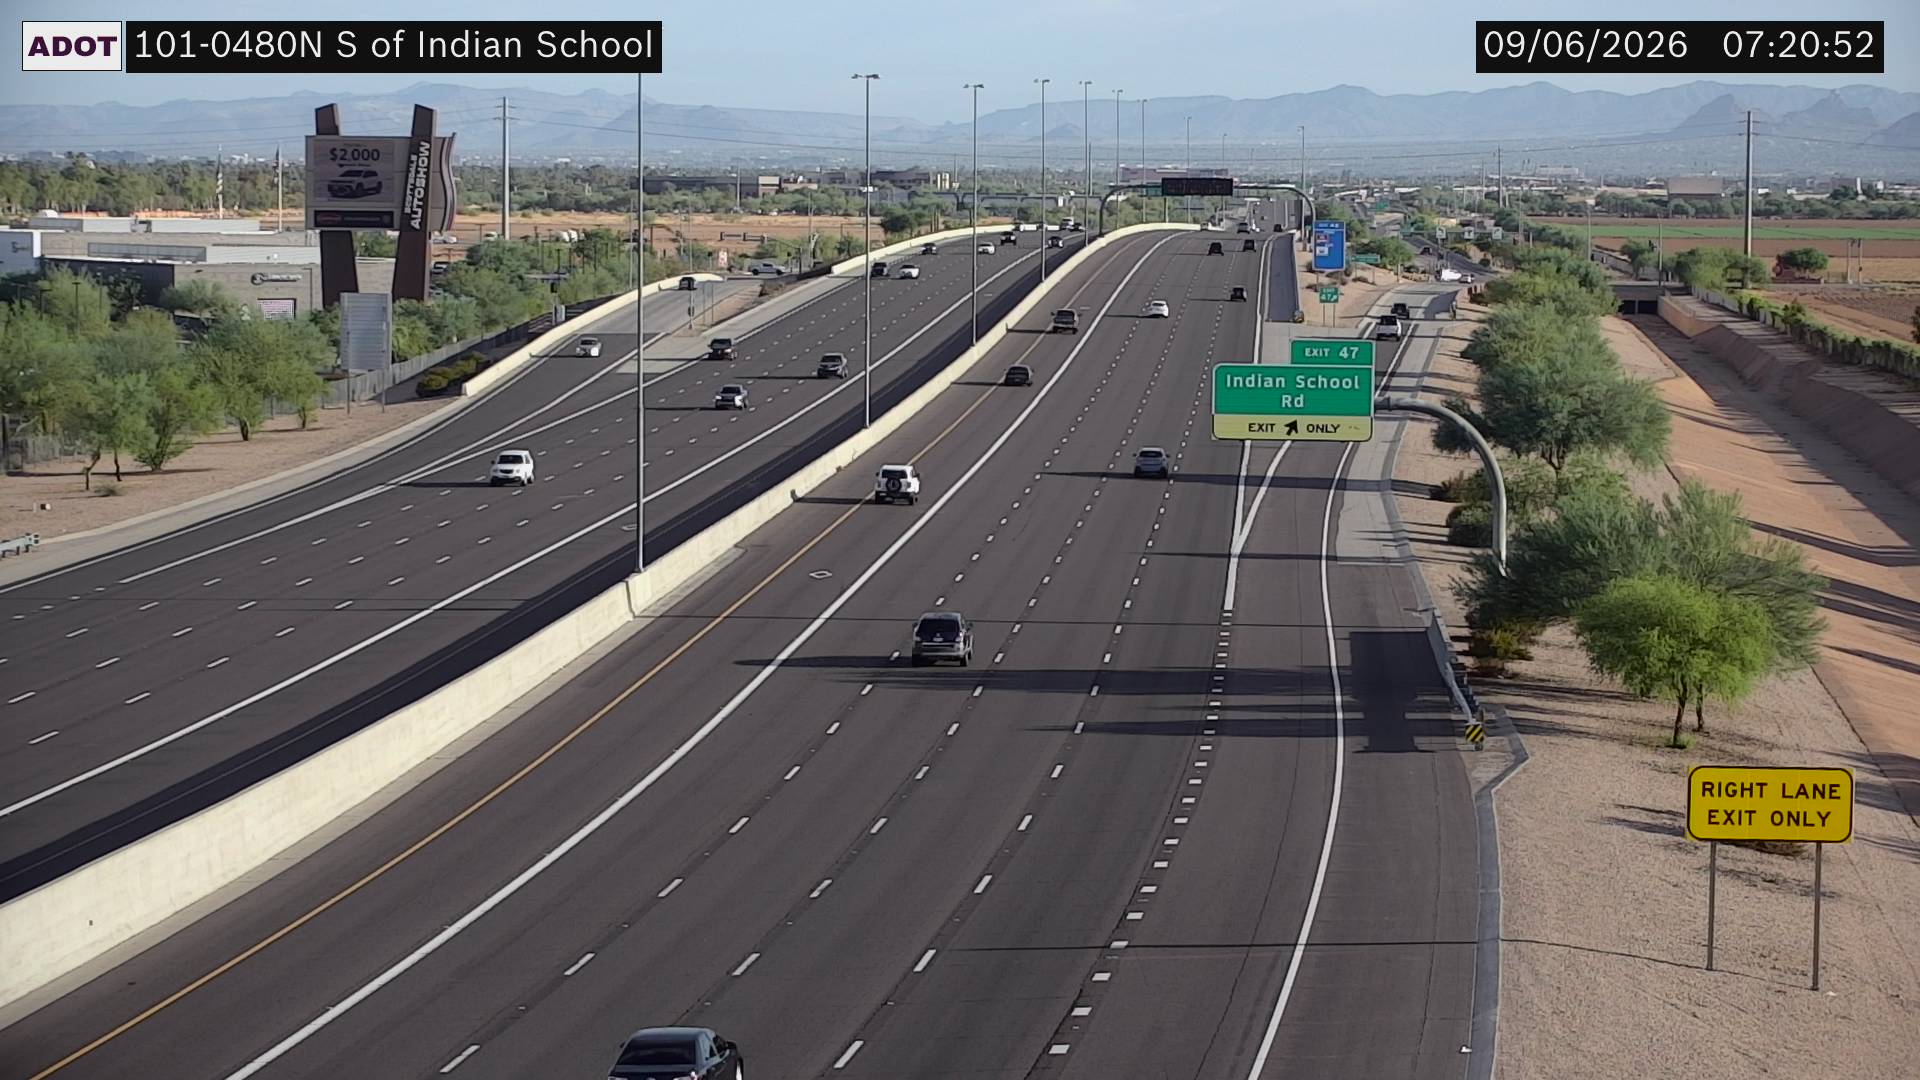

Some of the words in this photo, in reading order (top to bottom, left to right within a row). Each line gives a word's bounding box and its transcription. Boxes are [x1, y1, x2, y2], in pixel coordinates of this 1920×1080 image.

[410, 141, 431, 230] AUTOSHOW
[1305, 347, 1330, 357] EXIT
[1339, 346, 1359, 359] 47
[1226, 373, 1285, 388] Indian
[1295, 374, 1360, 389] School
[1281, 394, 1304, 408] Rd
[1248, 422, 1276, 433] EXIT
[1306, 423, 1341, 434] ONLY
[1701, 781, 1768, 799] RIGHT
[1781, 782, 1841, 800] LANE
[1707, 808, 1757, 826] EXIT
[1770, 810, 1832, 828] ONLY
